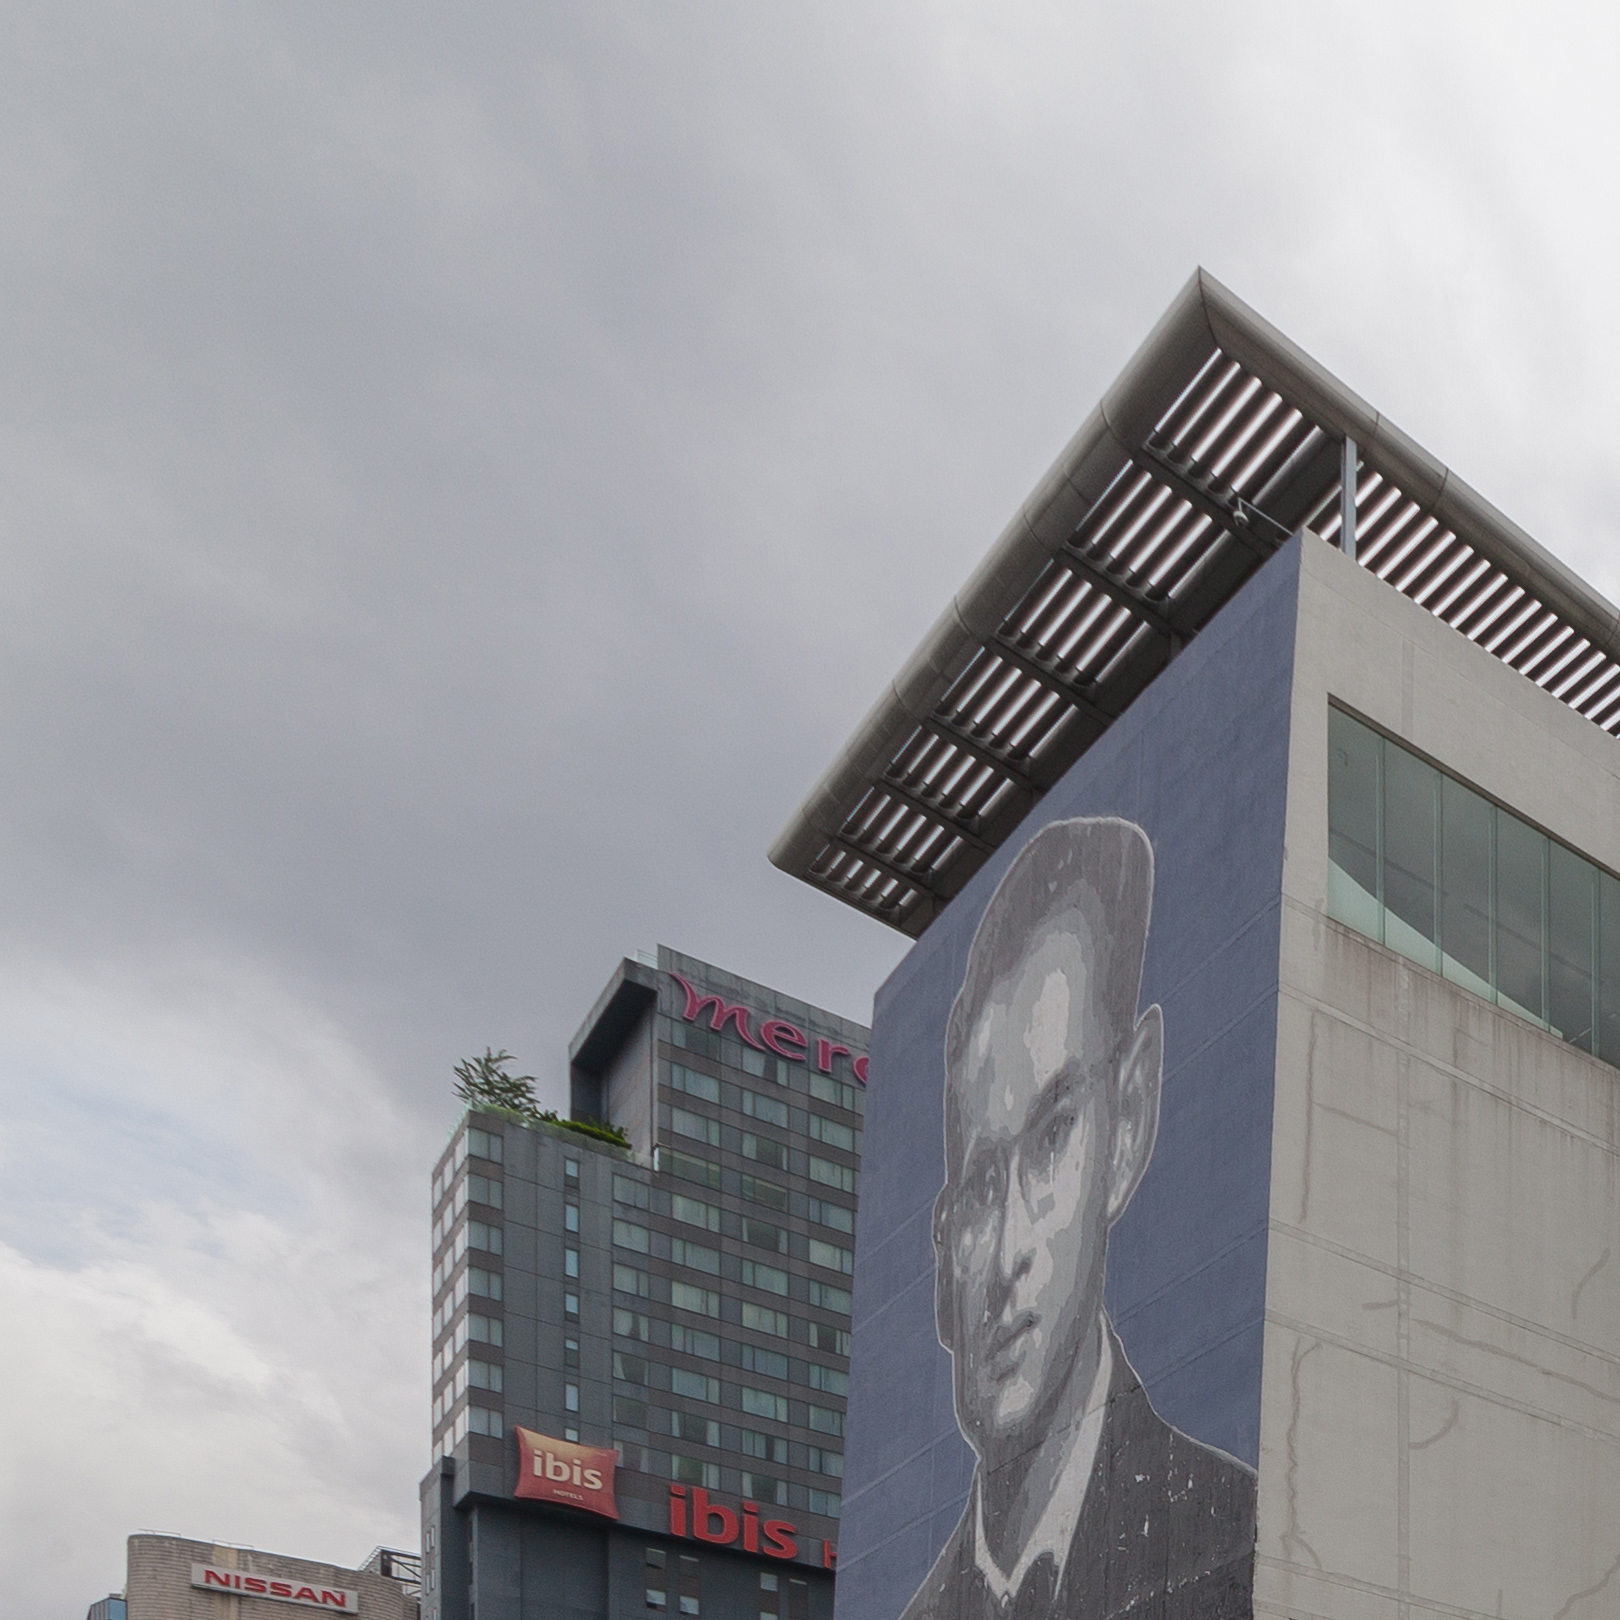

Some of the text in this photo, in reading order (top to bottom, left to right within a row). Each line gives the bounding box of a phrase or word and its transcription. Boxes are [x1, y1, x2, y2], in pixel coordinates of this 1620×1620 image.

[532, 1449, 603, 1491] ibis
[553, 1488, 584, 1501] HOTELS
[669, 1484, 798, 1559] ibis
[204, 1569, 346, 1608] NISSAN
